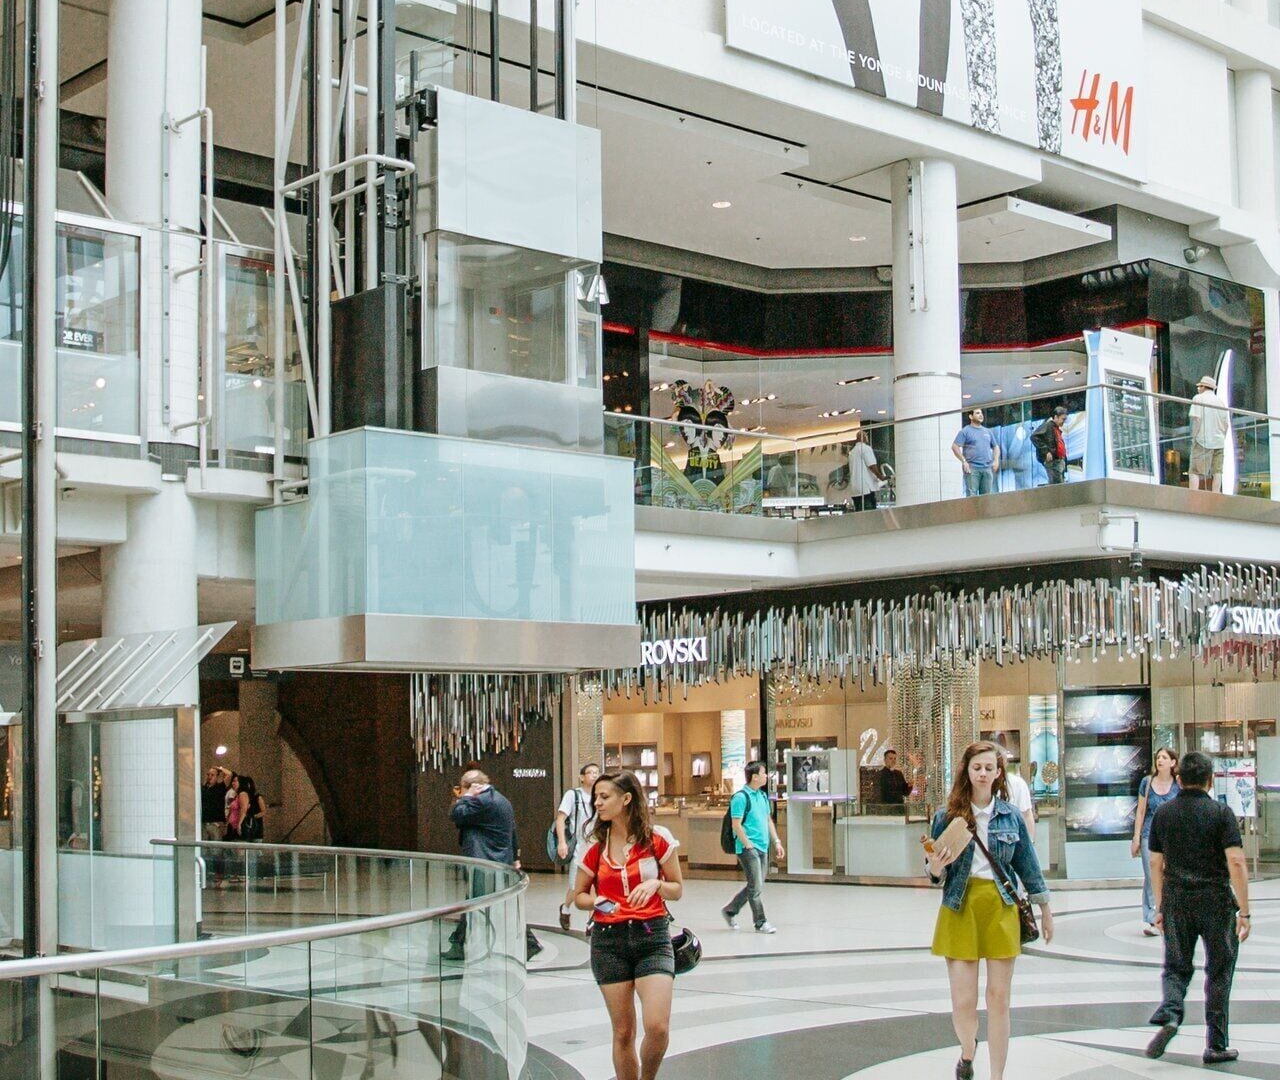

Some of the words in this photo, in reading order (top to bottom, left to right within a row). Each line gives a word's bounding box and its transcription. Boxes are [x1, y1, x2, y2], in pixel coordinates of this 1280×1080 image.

[741, 13, 806, 47] LOCATED
[808, 38, 825, 54] AT
[829, 44, 856, 65] THE
[858, 53, 902, 80] YONGE
[918, 73, 967, 101] DUNDAS
[1069, 68, 1134, 156] H&M
[641, 636, 708, 666] ROVSKI
